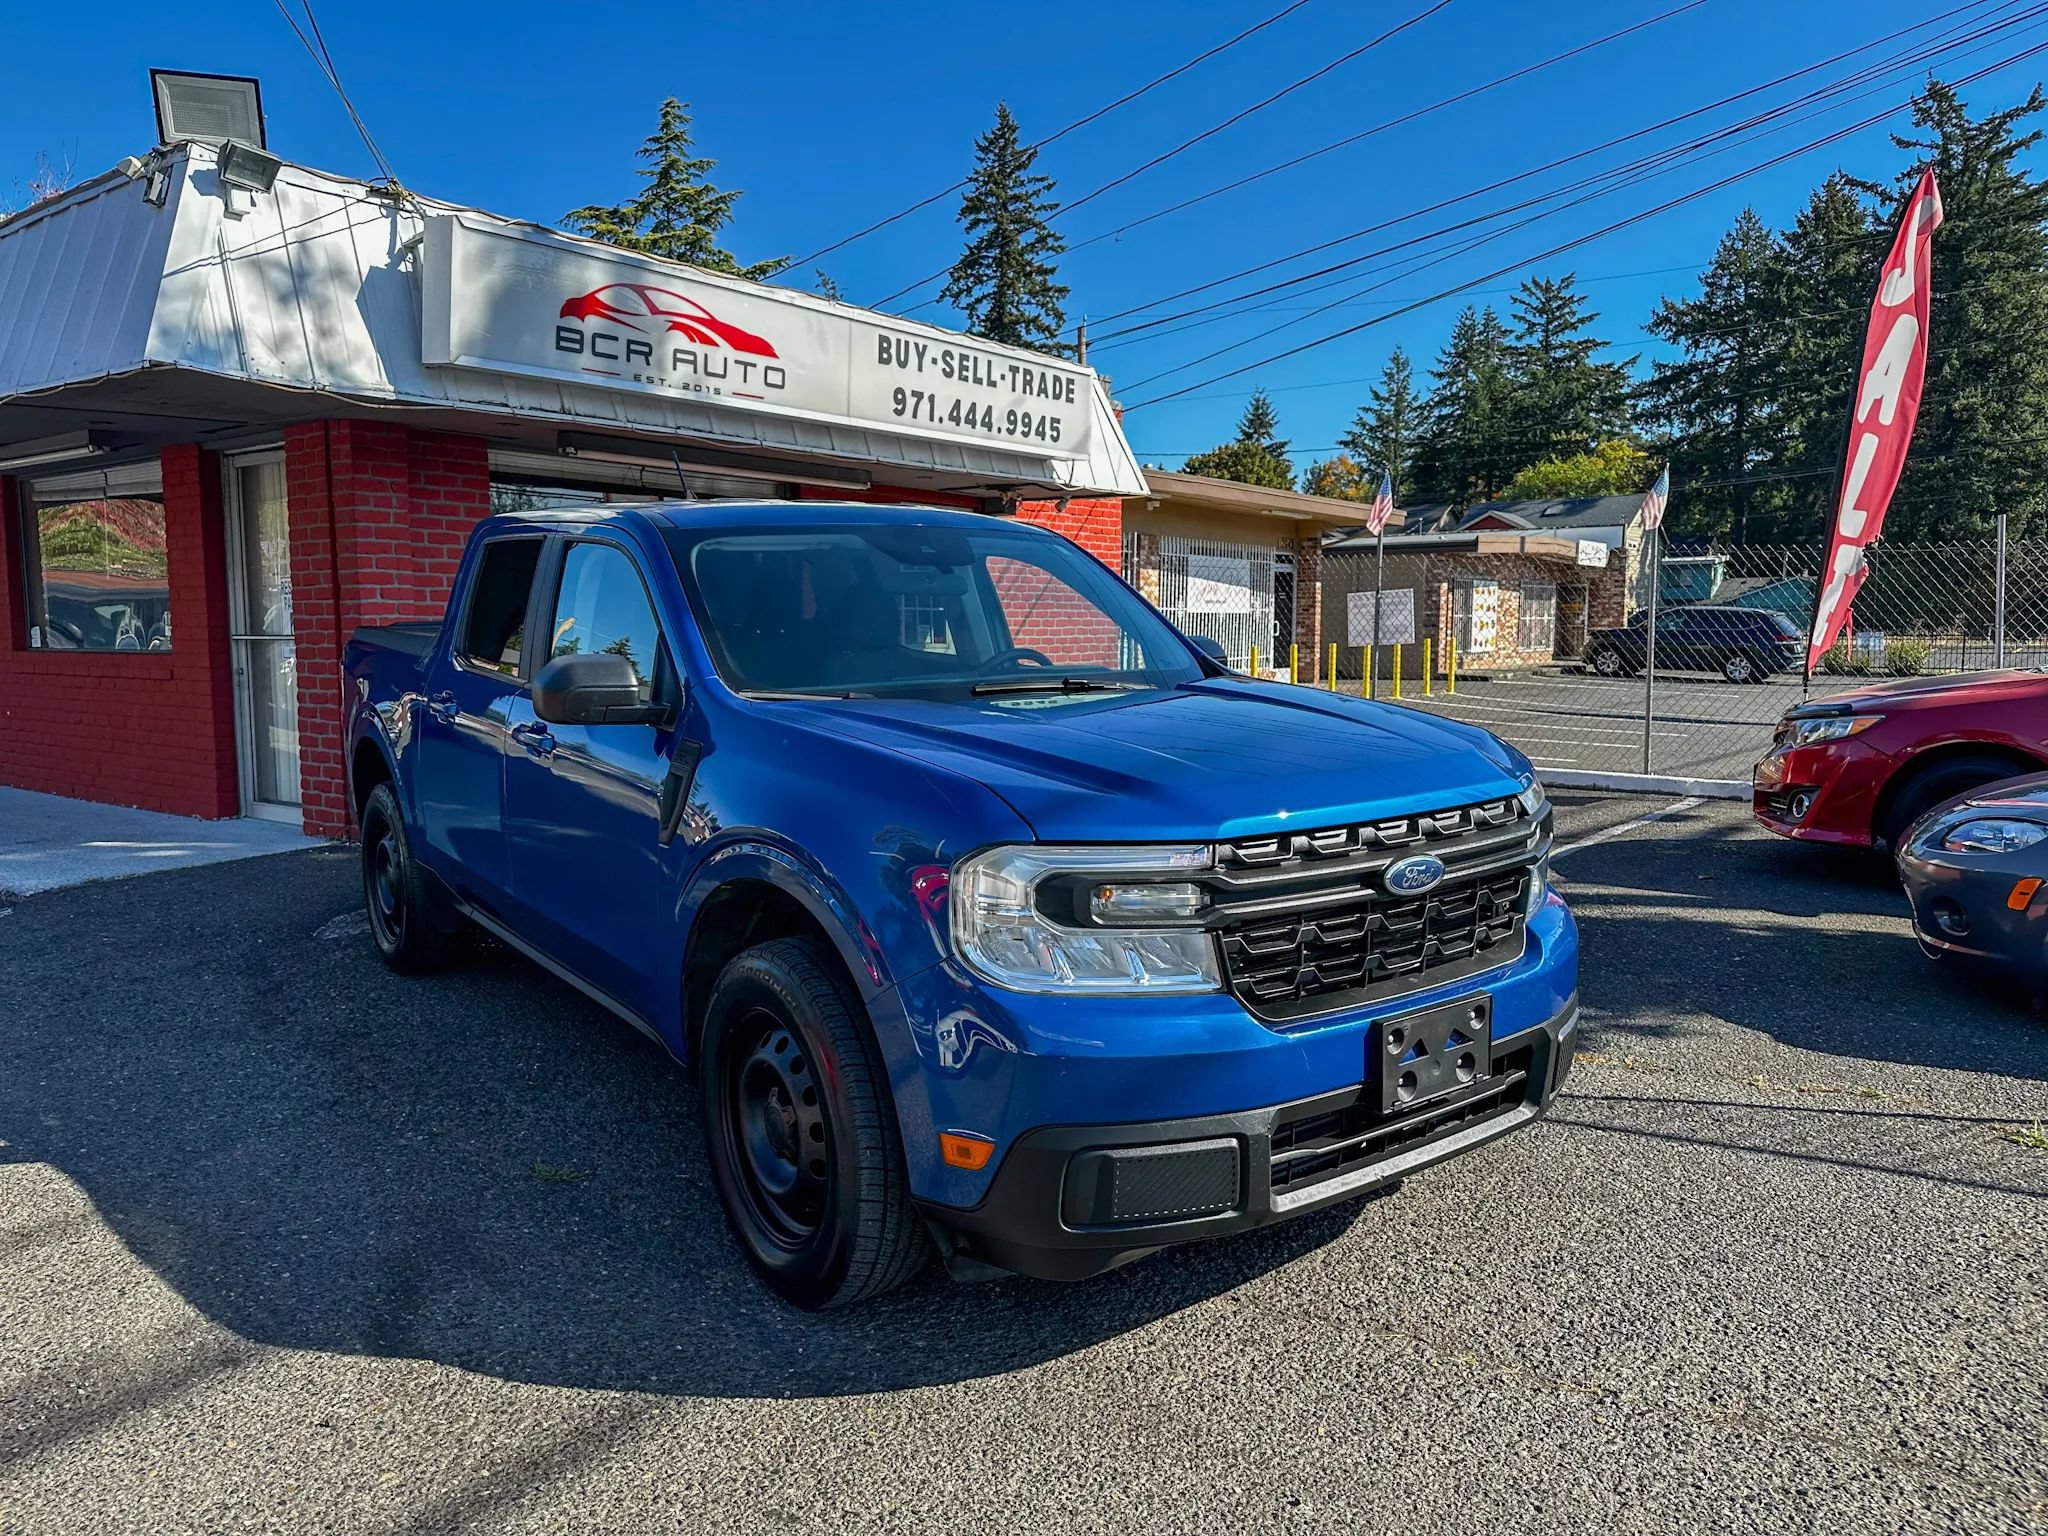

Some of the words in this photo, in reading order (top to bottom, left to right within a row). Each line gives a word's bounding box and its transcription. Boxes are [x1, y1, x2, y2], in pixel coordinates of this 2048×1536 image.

[556, 325, 652, 366] BCR
[672, 348, 786, 390] AUTO
[633, 373, 672, 388] EST.
[681, 382, 722, 395] 2015
[892, 386, 1061, 443] 971.444.9945
[1403, 865, 1434, 888] Ford
